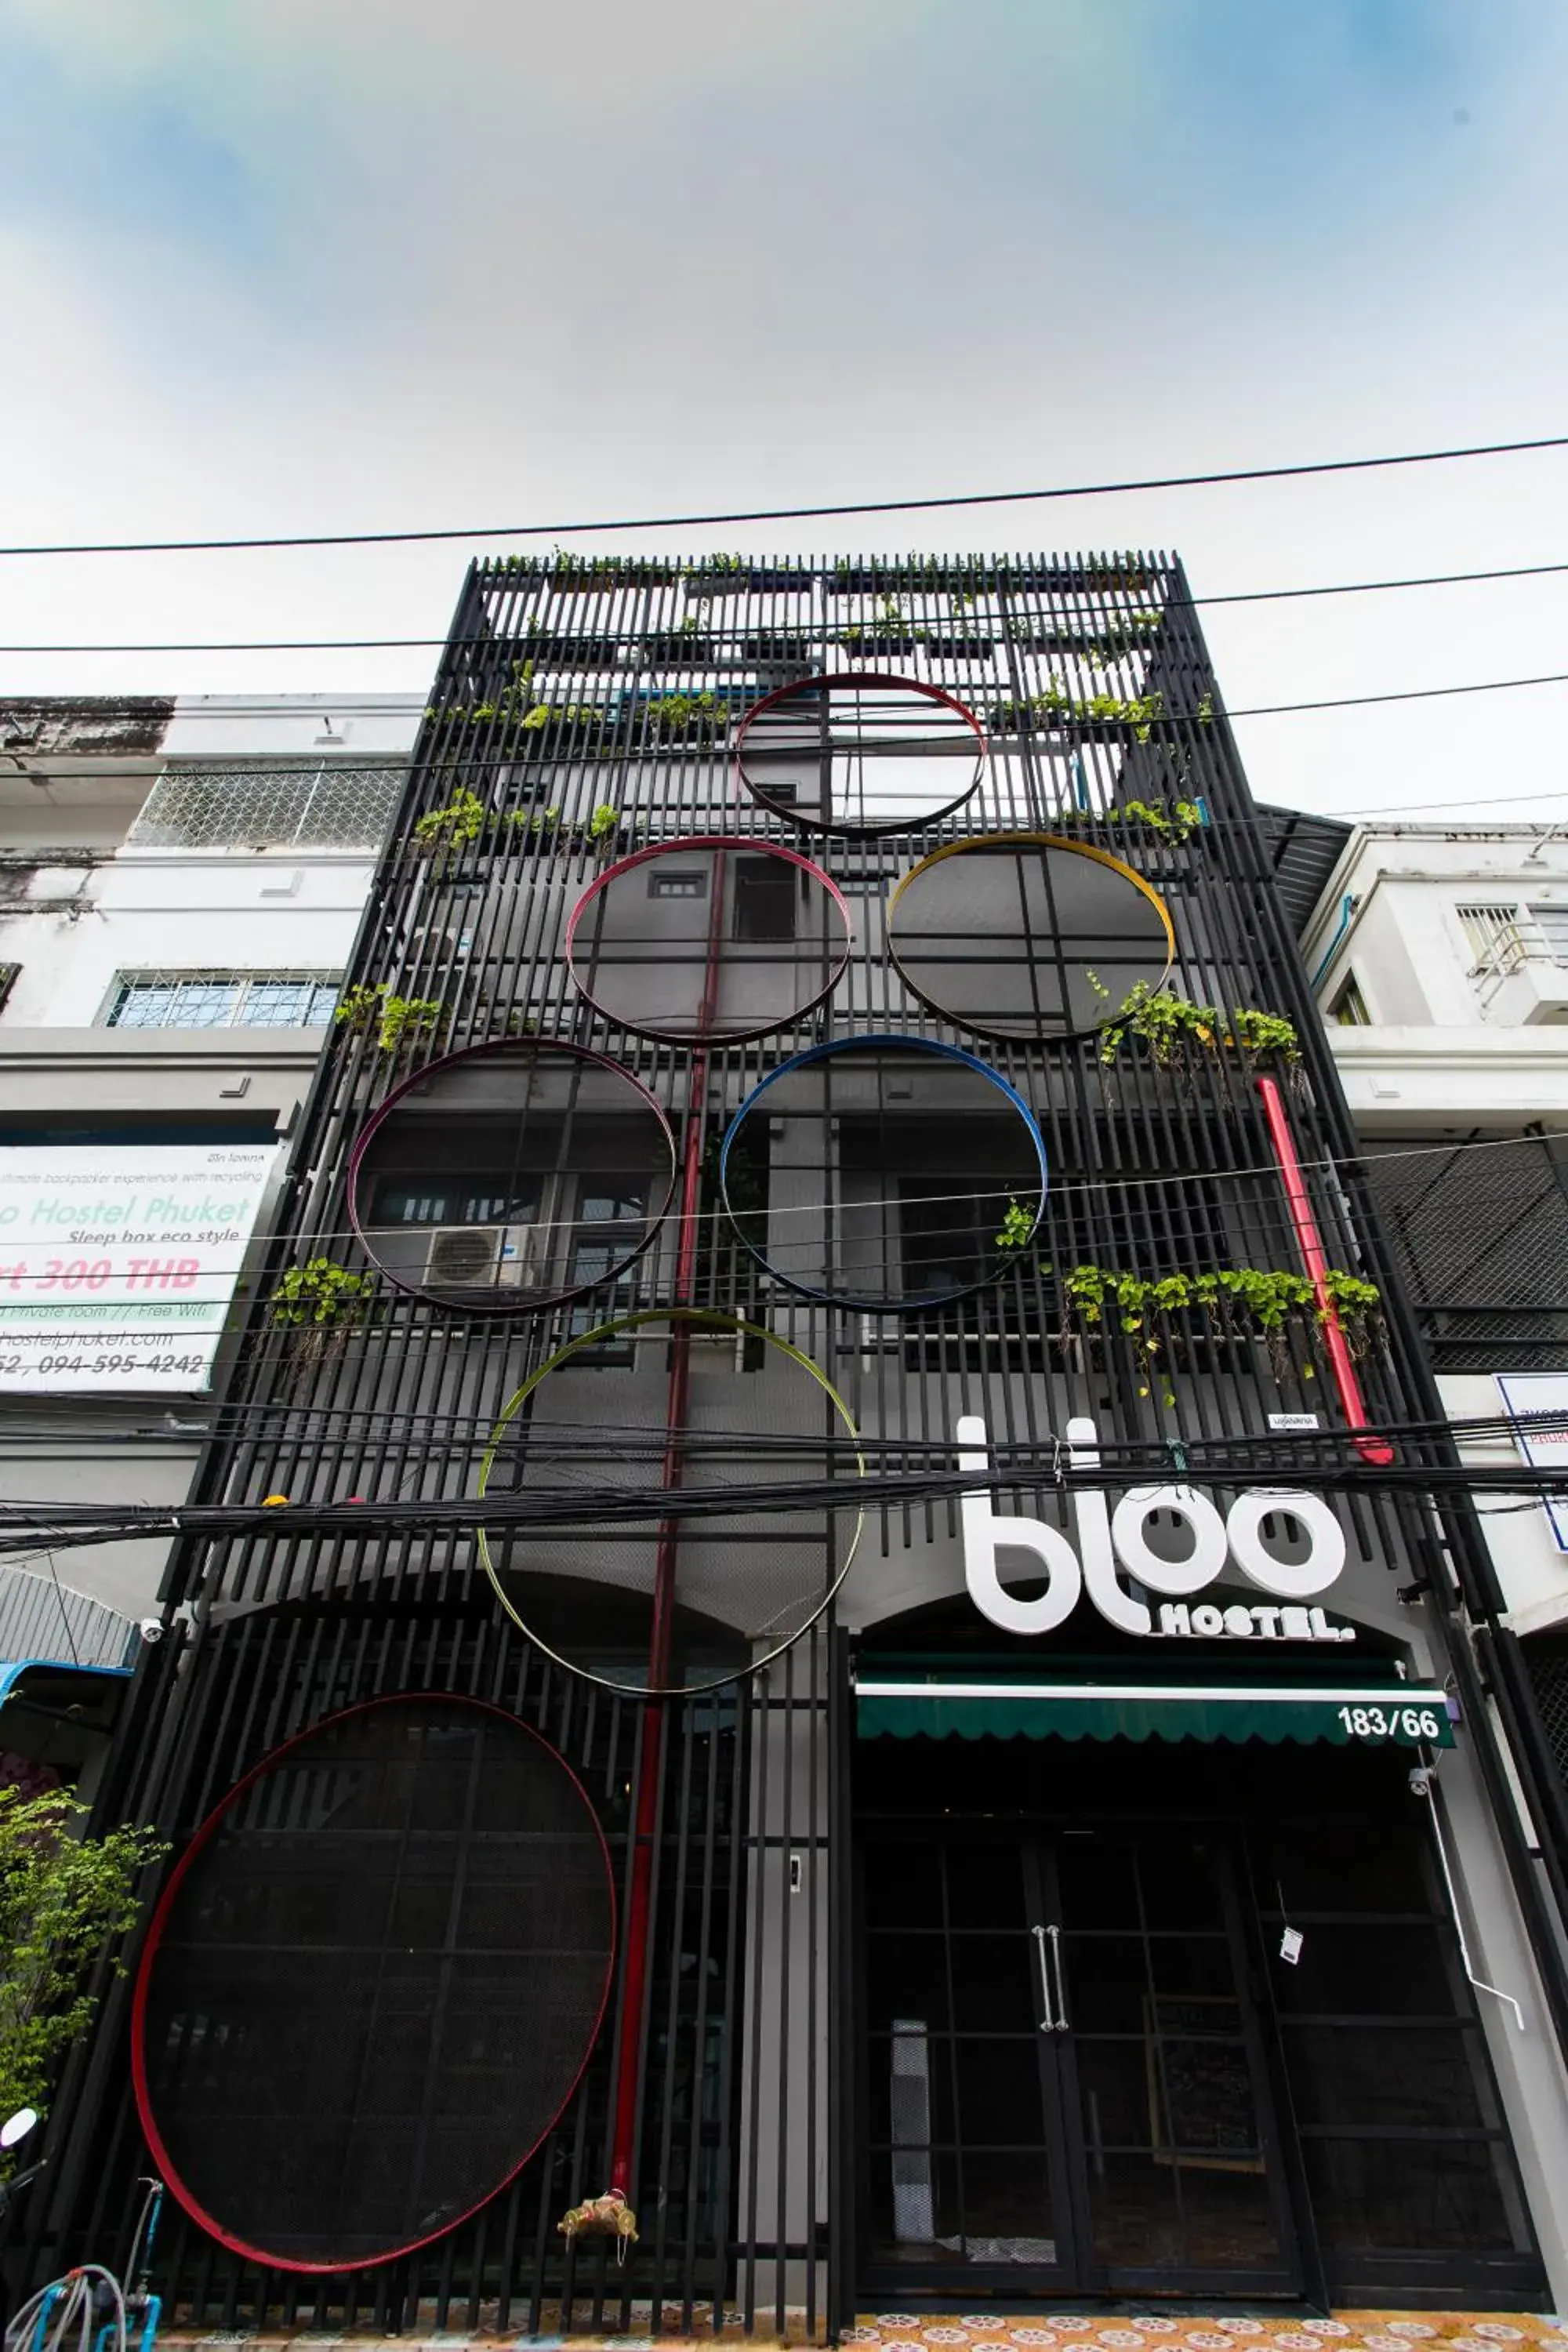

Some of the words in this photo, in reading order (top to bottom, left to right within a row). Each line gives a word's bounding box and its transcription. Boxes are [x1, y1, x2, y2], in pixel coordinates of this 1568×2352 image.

[113, 1173, 179, 1185] experience
[182, 1171, 207, 1183] with
[210, 1171, 263, 1184] recycling
[31, 1196, 136, 1225] Hostel
[143, 1195, 251, 1224] Phuket
[68, 1231, 116, 1247] Sleep
[122, 1230, 155, 1243] box
[161, 1232, 191, 1243] eco
[196, 1229, 239, 1244] style
[36, 1260, 112, 1290] 300
[125, 1258, 200, 1290] THB
[10, 1305, 64, 1319] Private
[68, 1305, 107, 1318] room
[138, 1305, 172, 1316] Free
[38, 1354, 205, 1374] 094-595-4242
[956, 1415, 1347, 1637] bloo
[1338, 1706, 1440, 1739] 183/66
